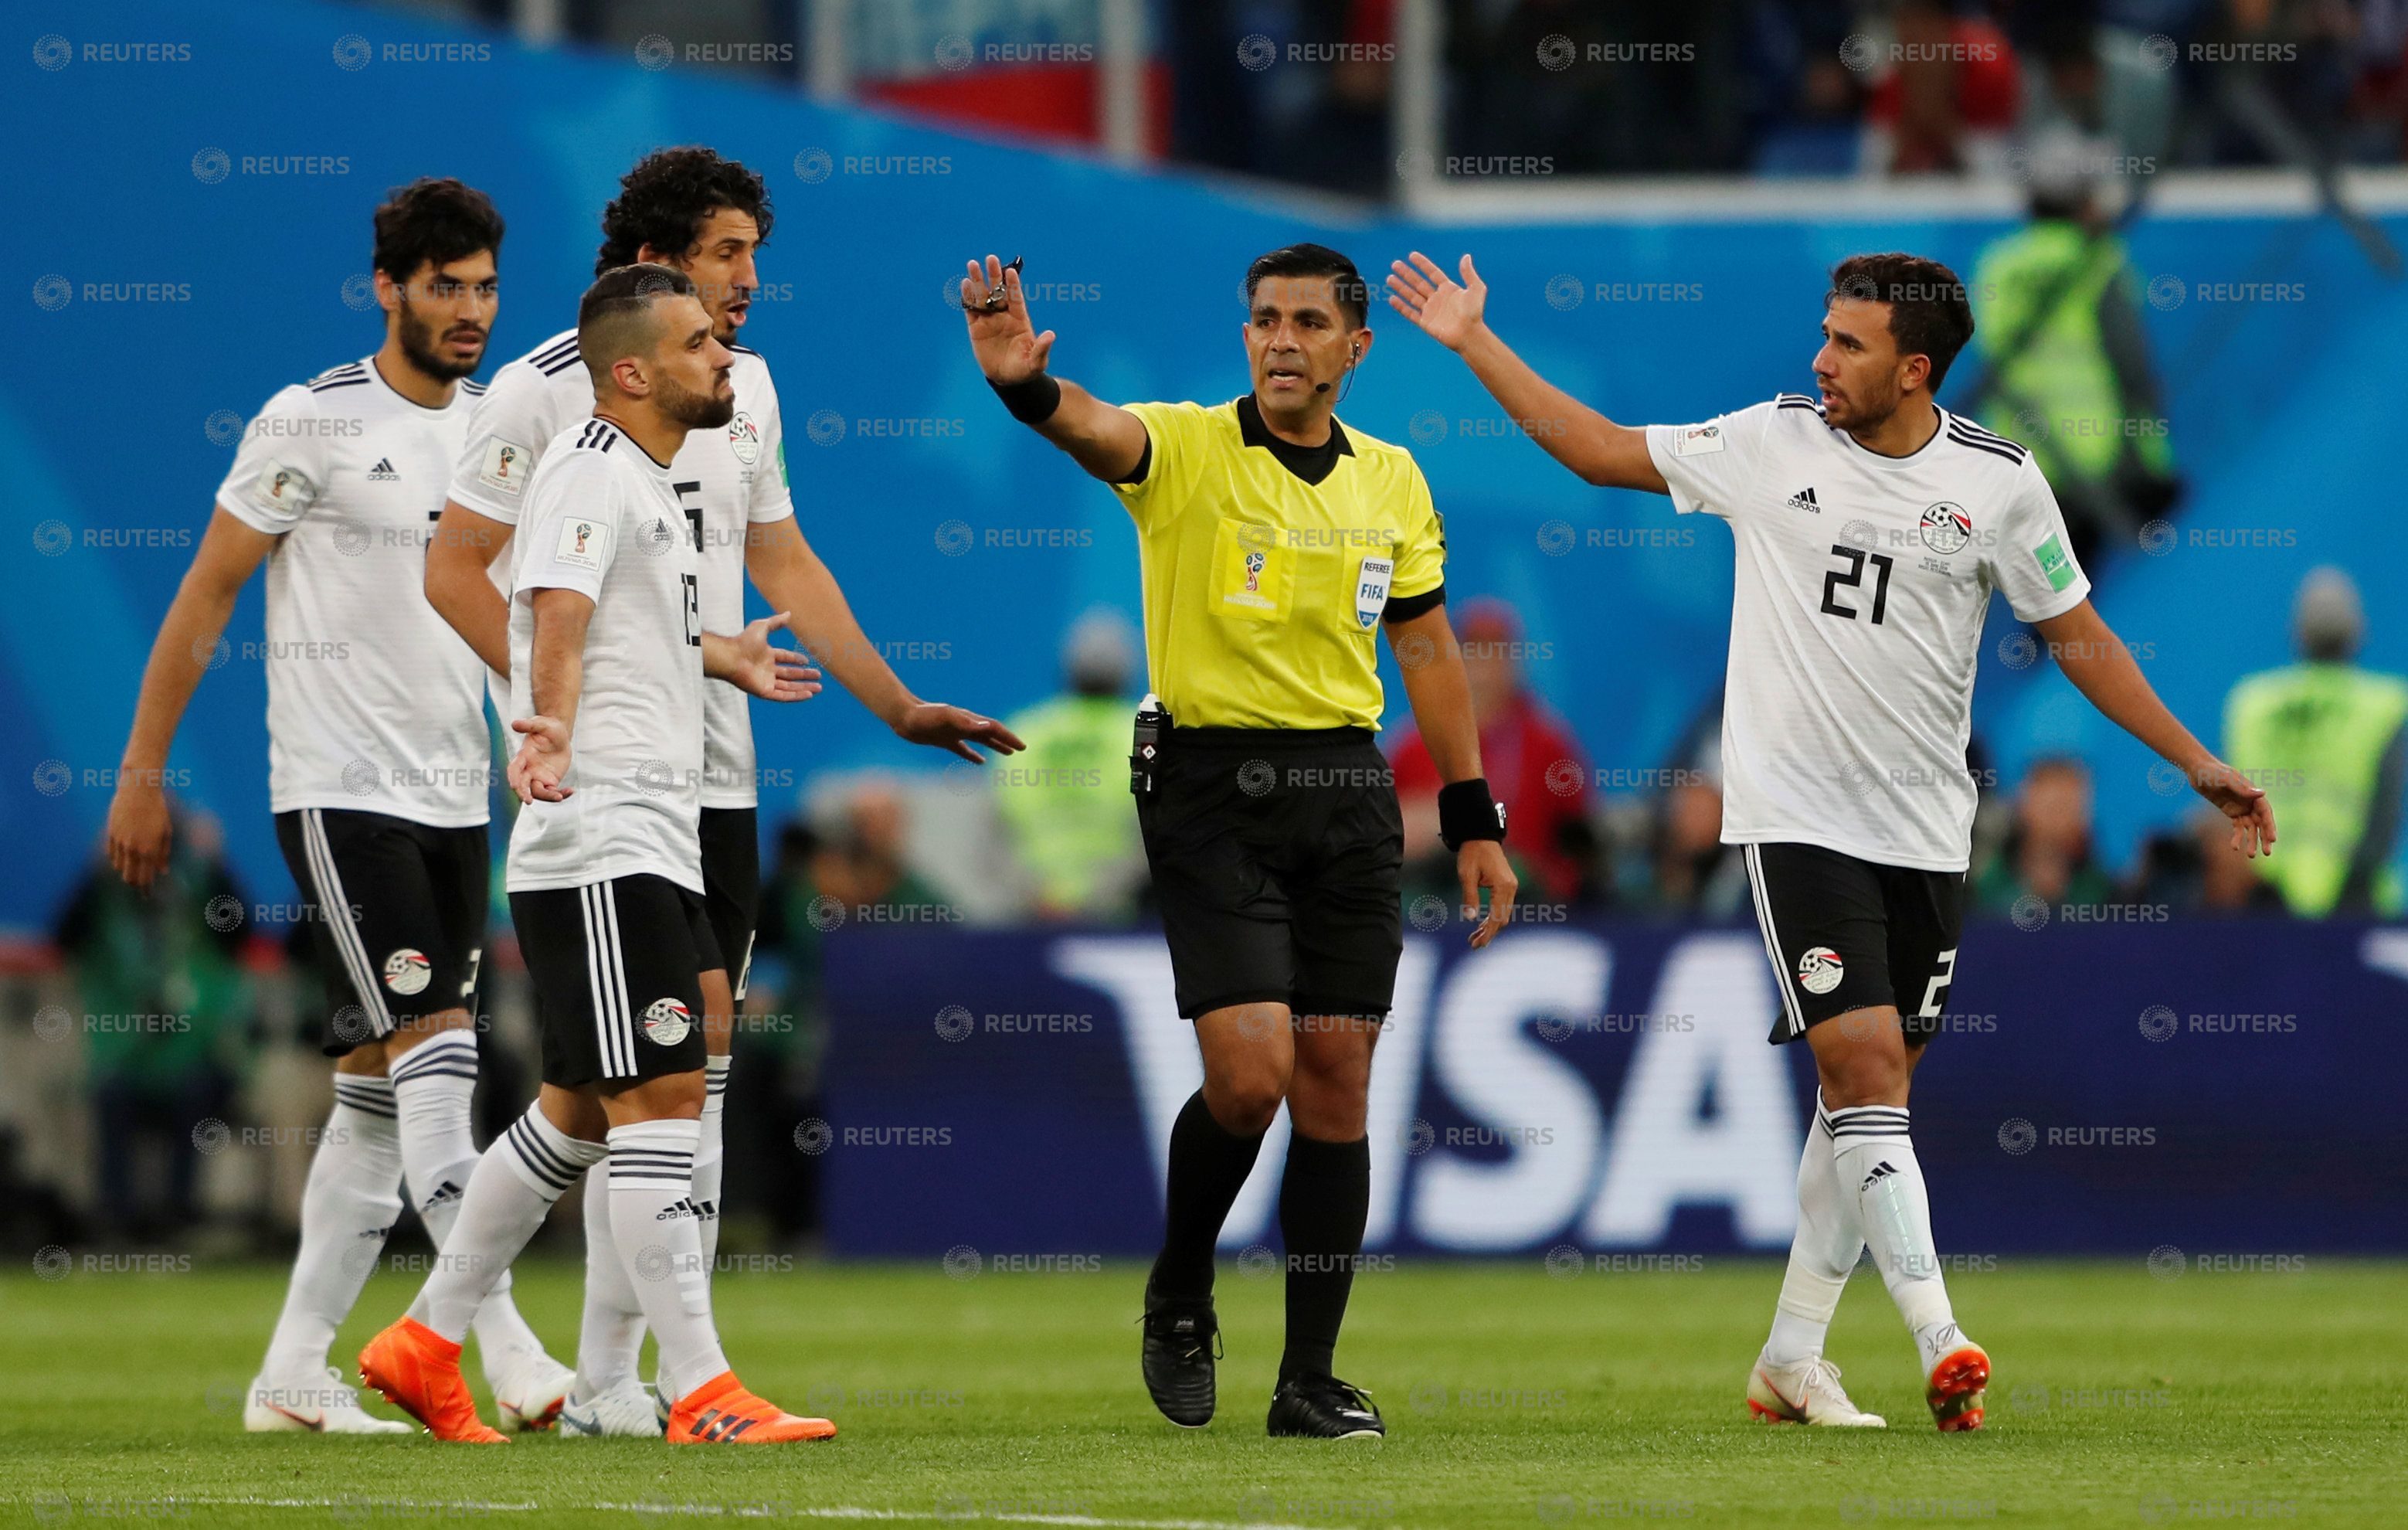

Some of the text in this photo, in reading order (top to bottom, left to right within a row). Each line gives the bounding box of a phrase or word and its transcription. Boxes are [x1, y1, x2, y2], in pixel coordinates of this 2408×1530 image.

[1788, 497, 1822, 514] adidas
[1364, 562, 1391, 574] REFEREE
[1360, 583, 1384, 601] FIFA
[1820, 543, 1893, 625] 21
